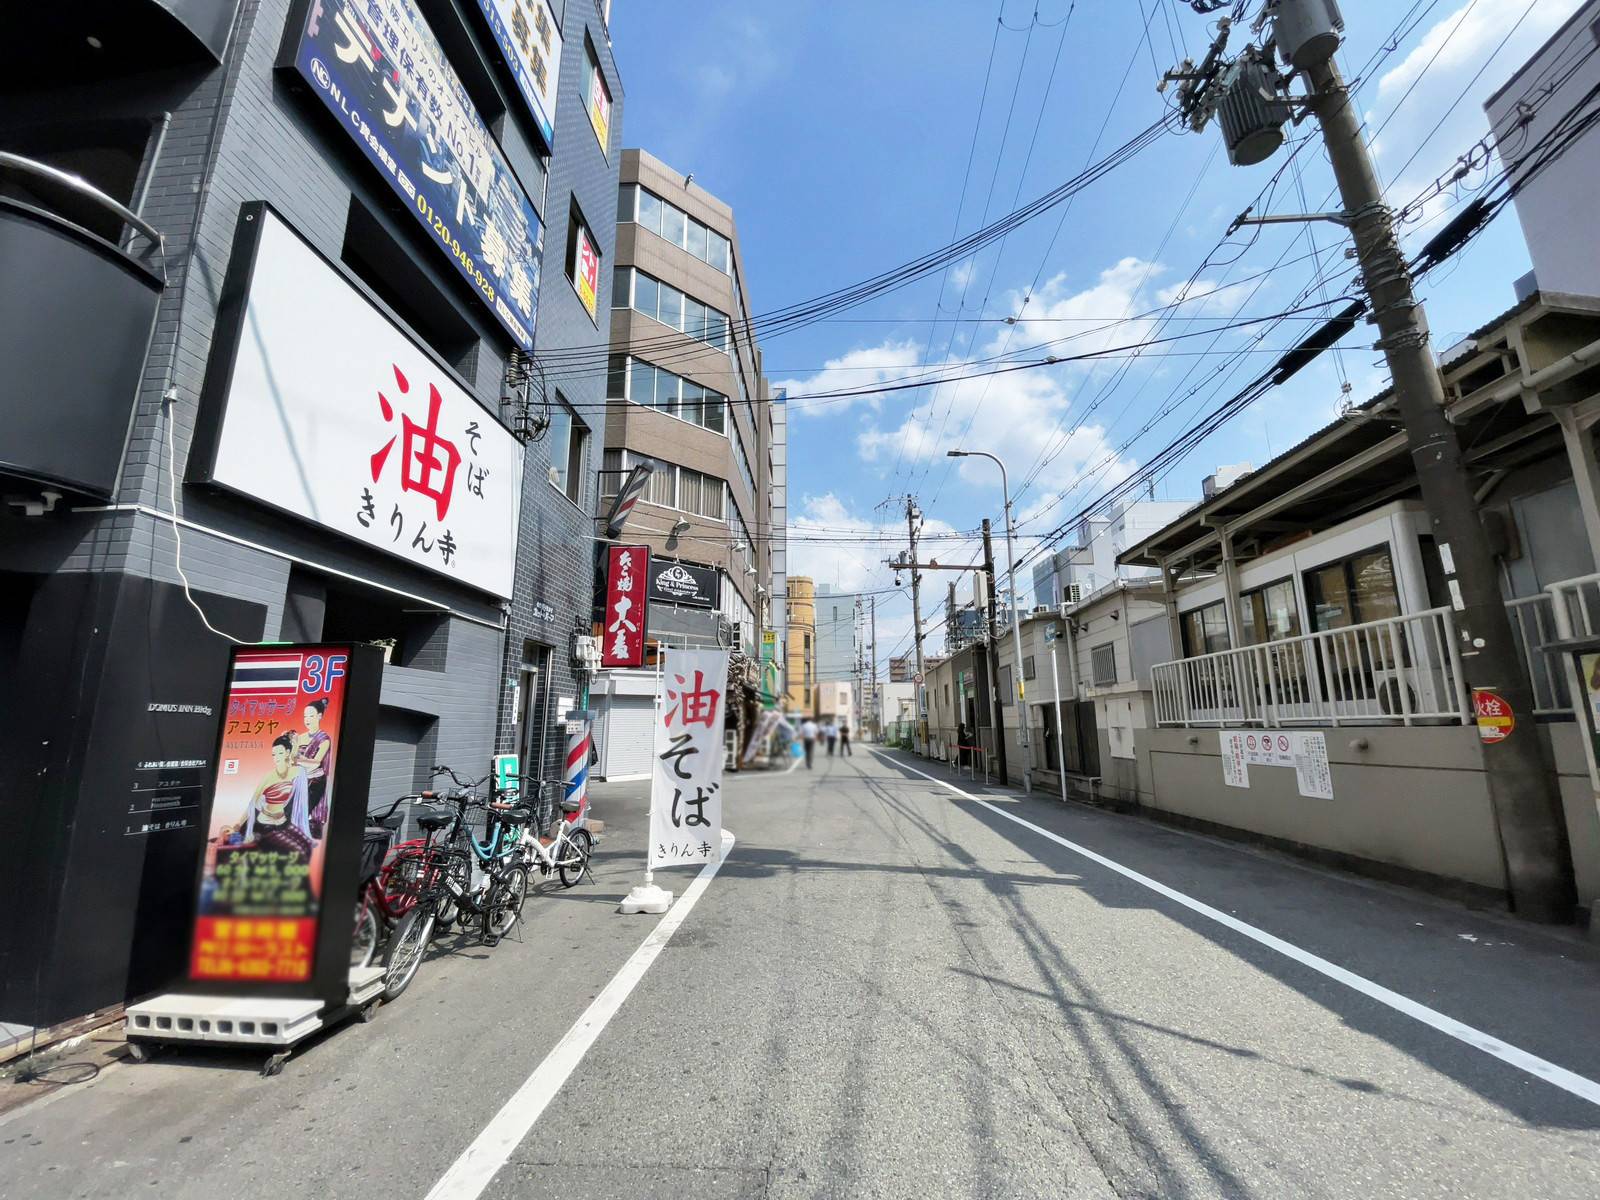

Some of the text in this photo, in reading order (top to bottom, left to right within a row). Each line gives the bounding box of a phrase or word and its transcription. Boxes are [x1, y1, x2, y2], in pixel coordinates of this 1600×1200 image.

[334, 6, 532, 319] テナント募集
[417, 194, 495, 302] 0120-946-928
[370, 363, 462, 522] 油
[465, 421, 490, 500] そば
[356, 487, 457, 566] きりん寺
[302, 655, 348, 693] 3F
[148, 703, 178, 712] DOMUS
[178, 705, 194, 713] INN
[227, 719, 280, 735] アユタヤ
[229, 698, 297, 716] タイマッサージ
[657, 840, 712, 859] きりん寺
